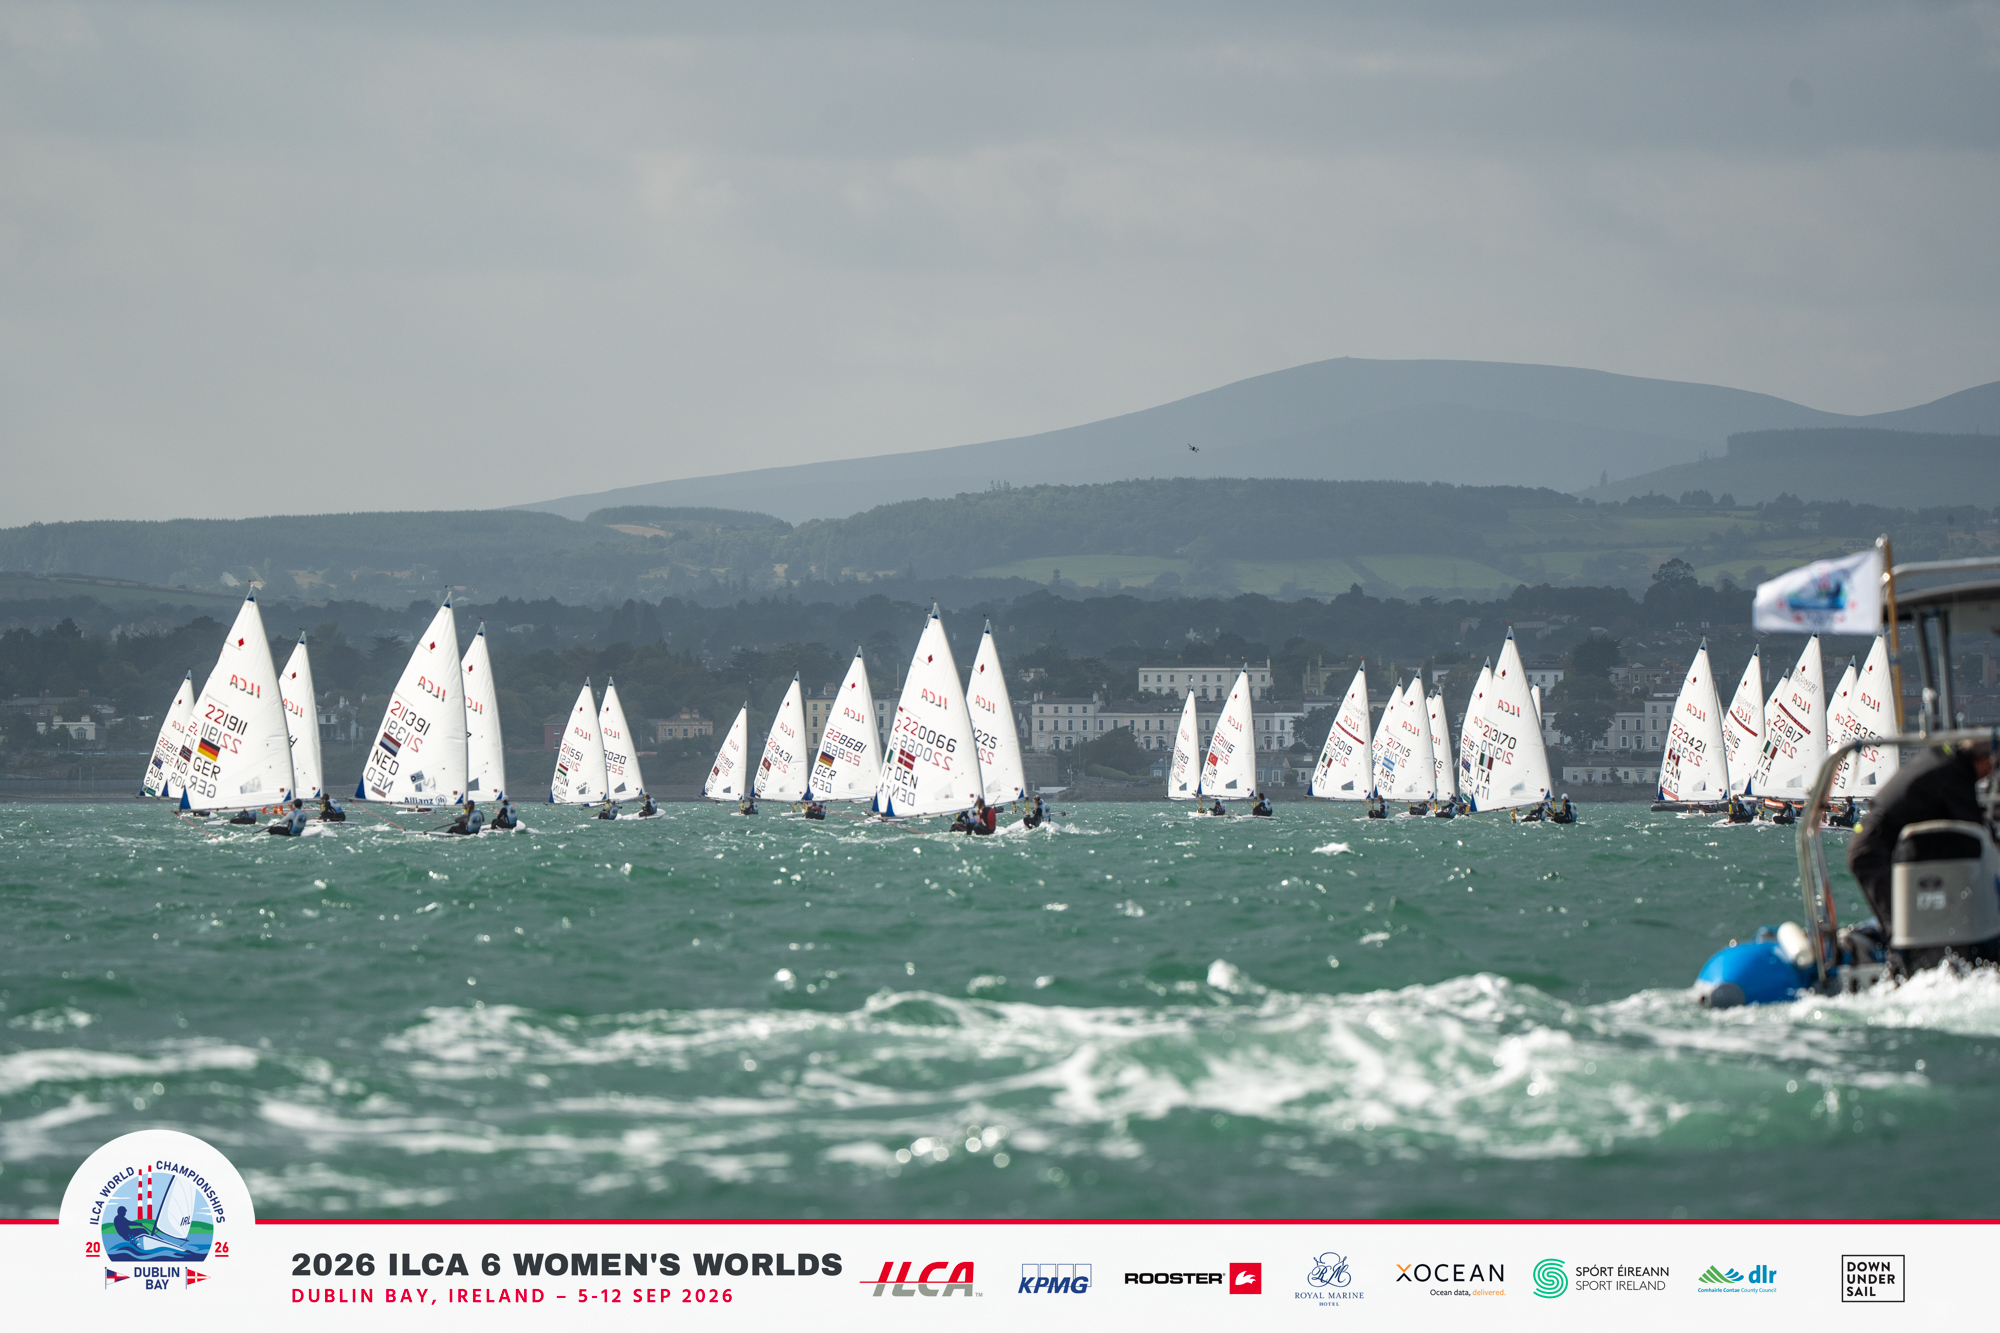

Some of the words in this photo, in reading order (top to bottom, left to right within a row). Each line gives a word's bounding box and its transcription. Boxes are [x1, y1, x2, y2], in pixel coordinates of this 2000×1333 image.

[204, 703, 248, 736] 221911
[390, 700, 431, 736] 211391
[1773, 714, 1804, 744] 221817
[825, 727, 868, 754] 228681
[903, 716, 958, 753] 220066
[1213, 731, 1236, 754] 221116
[1328, 731, 1353, 756] 213019
[1462, 734, 1480, 756] 2187
[1482, 724, 1517, 750] 213170
[1671, 723, 1707, 754] 223421
[561, 743, 584, 762] 211551
[768, 737, 793, 764] 228431
[1386, 737, 1412, 758] 217115
[192, 756, 221, 782] GER
[371, 748, 400, 776] NED
[814, 764, 838, 781] GER
[1206, 761, 1218, 780] TUR
[1316, 763, 1329, 779] ITA
[1664, 761, 1682, 781] CAN
[1757, 753, 1773, 774] ITA
[149, 766, 164, 781] AUS
[555, 772, 570, 787] HUN
[894, 766, 919, 790] DEN
[1379, 767, 1396, 784] ARG
[1475, 767, 1491, 785] ITA
[404, 797, 433, 806] Allianz
